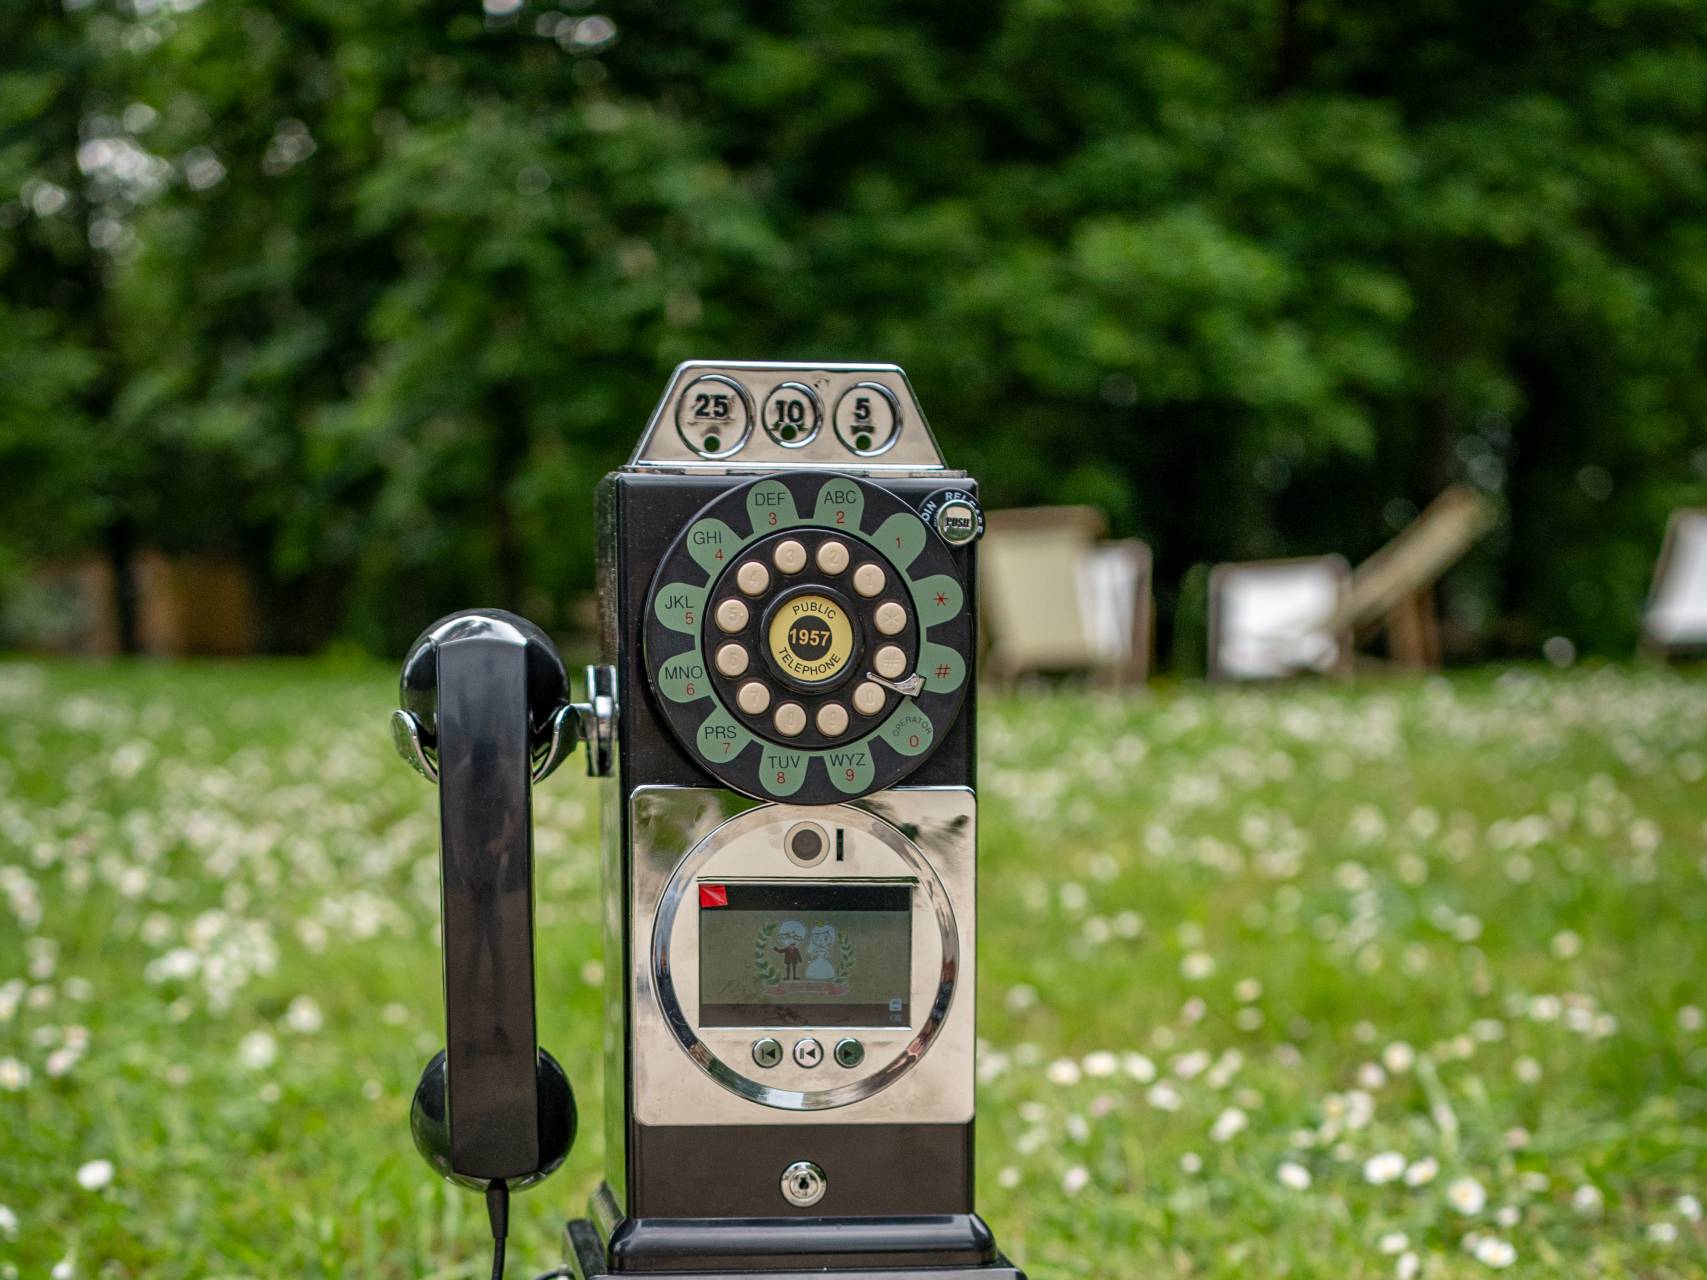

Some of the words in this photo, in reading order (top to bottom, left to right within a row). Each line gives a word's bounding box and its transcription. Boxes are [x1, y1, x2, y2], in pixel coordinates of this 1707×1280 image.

[694, 393, 729, 418] 25
[774, 399, 805, 423] 10
[854, 397, 871, 421] 5
[754, 492, 786, 507] DEF
[823, 490, 857, 505] ABC
[768, 511, 778, 526] 3
[836, 510, 845, 524] 2
[921, 500, 937, 522] OIN
[944, 517, 970, 528] PUSH
[692, 531, 723, 545] GHI
[895, 536, 901, 549] 1
[714, 547, 724, 561] 4
[664, 594, 695, 610] JKL
[792, 601, 837, 620] PUBLIC
[685, 612, 694, 625] 5
[789, 628, 831, 647] 1957
[778, 646, 841, 676] TELEPHONE
[664, 665, 704, 680] MNO
[935, 663, 952, 678] #
[686, 682, 695, 696] 6
[704, 725, 737, 739] PRS
[892, 715, 932, 737] OPERATOR
[723, 742, 732, 754] 7
[909, 735, 919, 748] 0
[768, 755, 800, 769] TUV
[829, 752, 866, 767] WYZ
[776, 771, 786, 784] 8
[845, 768, 855, 782] 9
